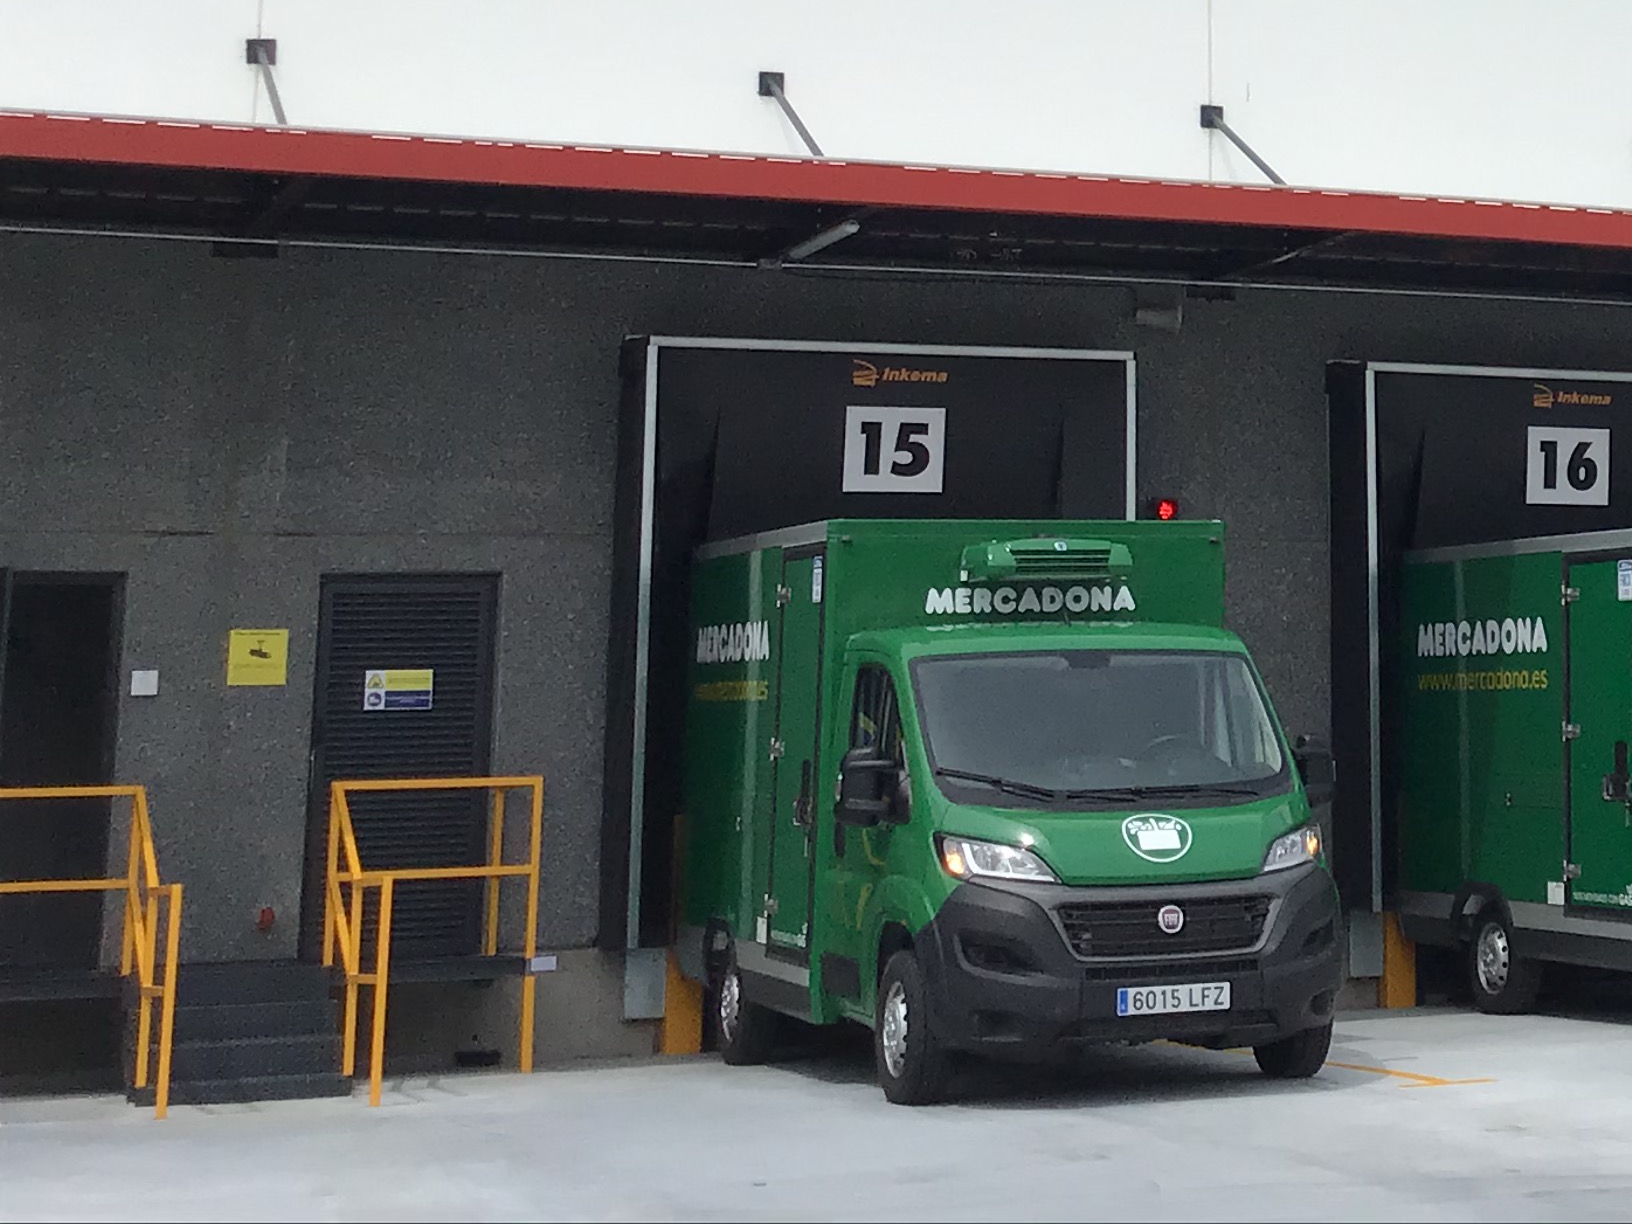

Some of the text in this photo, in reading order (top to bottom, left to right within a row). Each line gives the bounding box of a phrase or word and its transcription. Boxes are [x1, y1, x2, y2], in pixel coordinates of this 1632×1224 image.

[860, 421, 931, 478] 15
[1540, 440, 1598, 492] 16
[925, 585, 1136, 614] MERCADONA
[697, 620, 770, 663] MERCADONA
[1417, 616, 1548, 657] MERCADONA
[1418, 668, 1549, 690] www.mercadona.es
[1133, 986, 1225, 1011] 6015 LFZ
